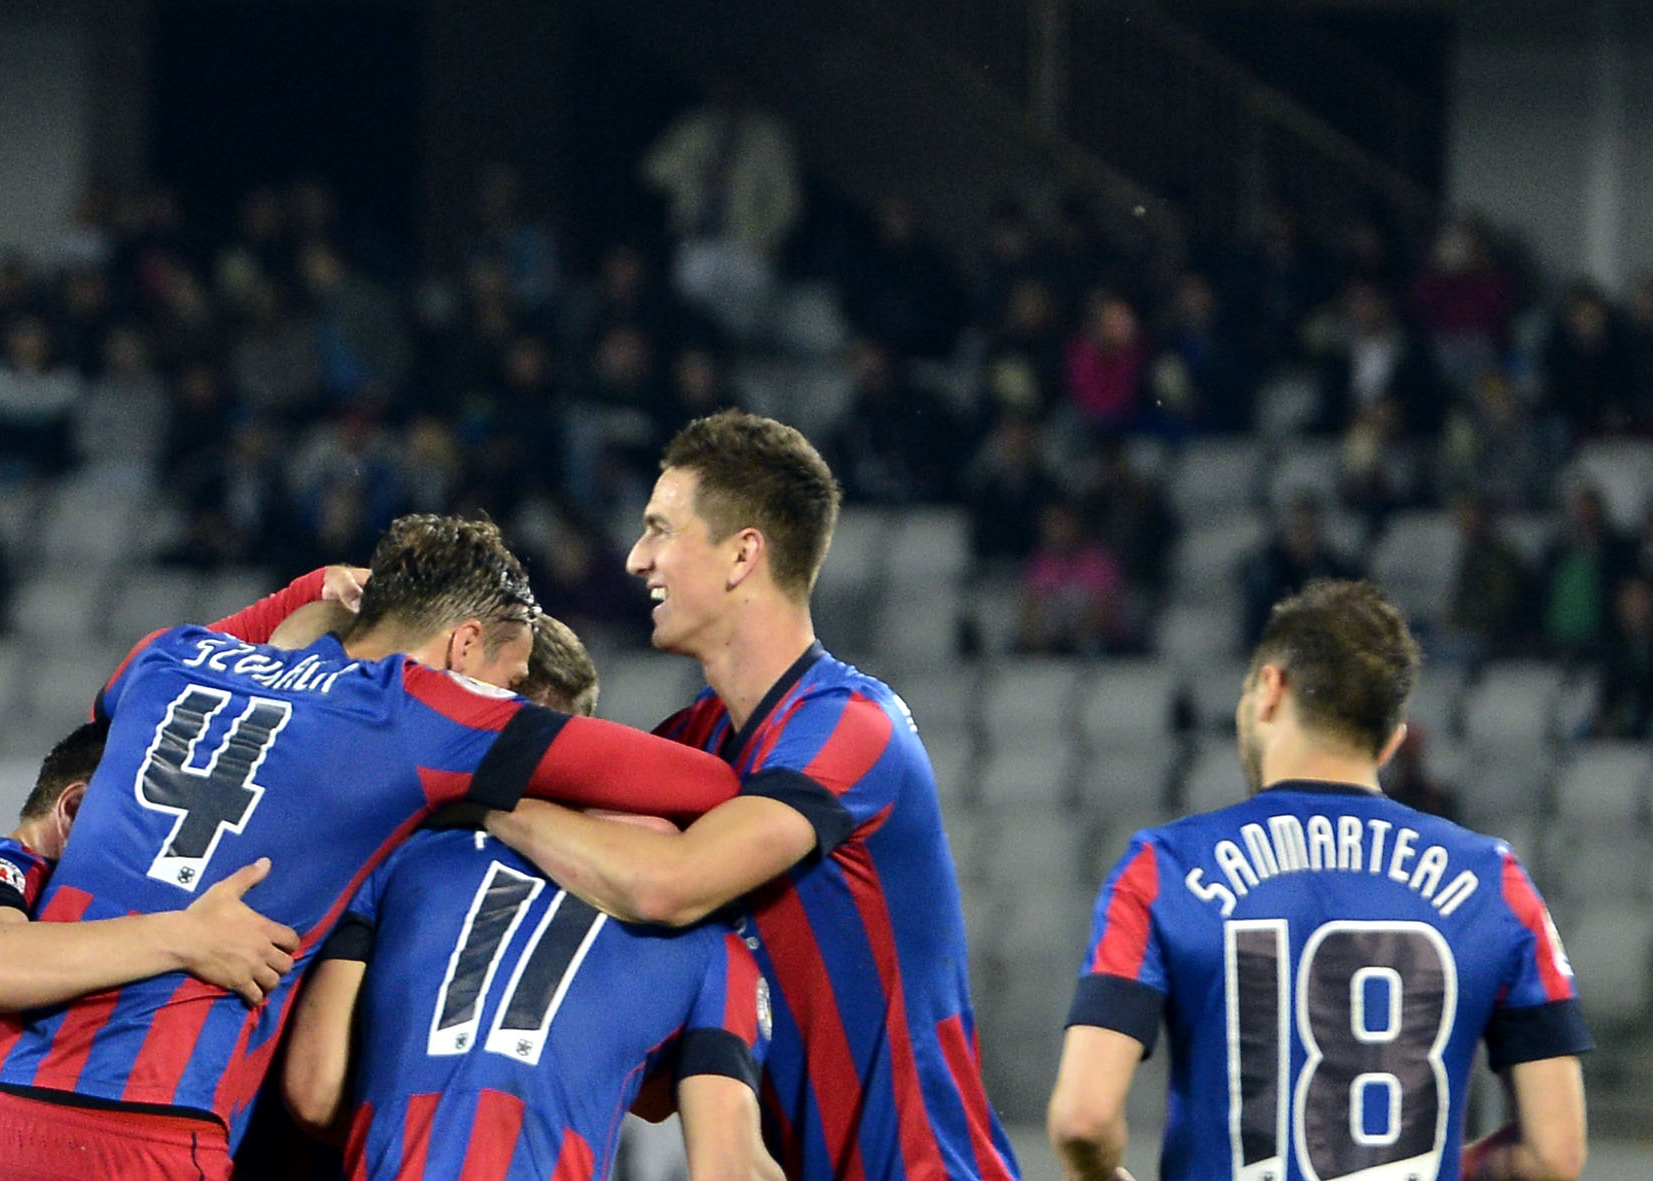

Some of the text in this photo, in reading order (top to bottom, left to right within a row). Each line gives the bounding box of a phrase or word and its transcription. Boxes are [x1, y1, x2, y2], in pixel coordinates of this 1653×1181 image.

[135, 684, 292, 892] 4
[1185, 814, 1480, 917] SANMARTEAN
[426, 860, 609, 1066] 11
